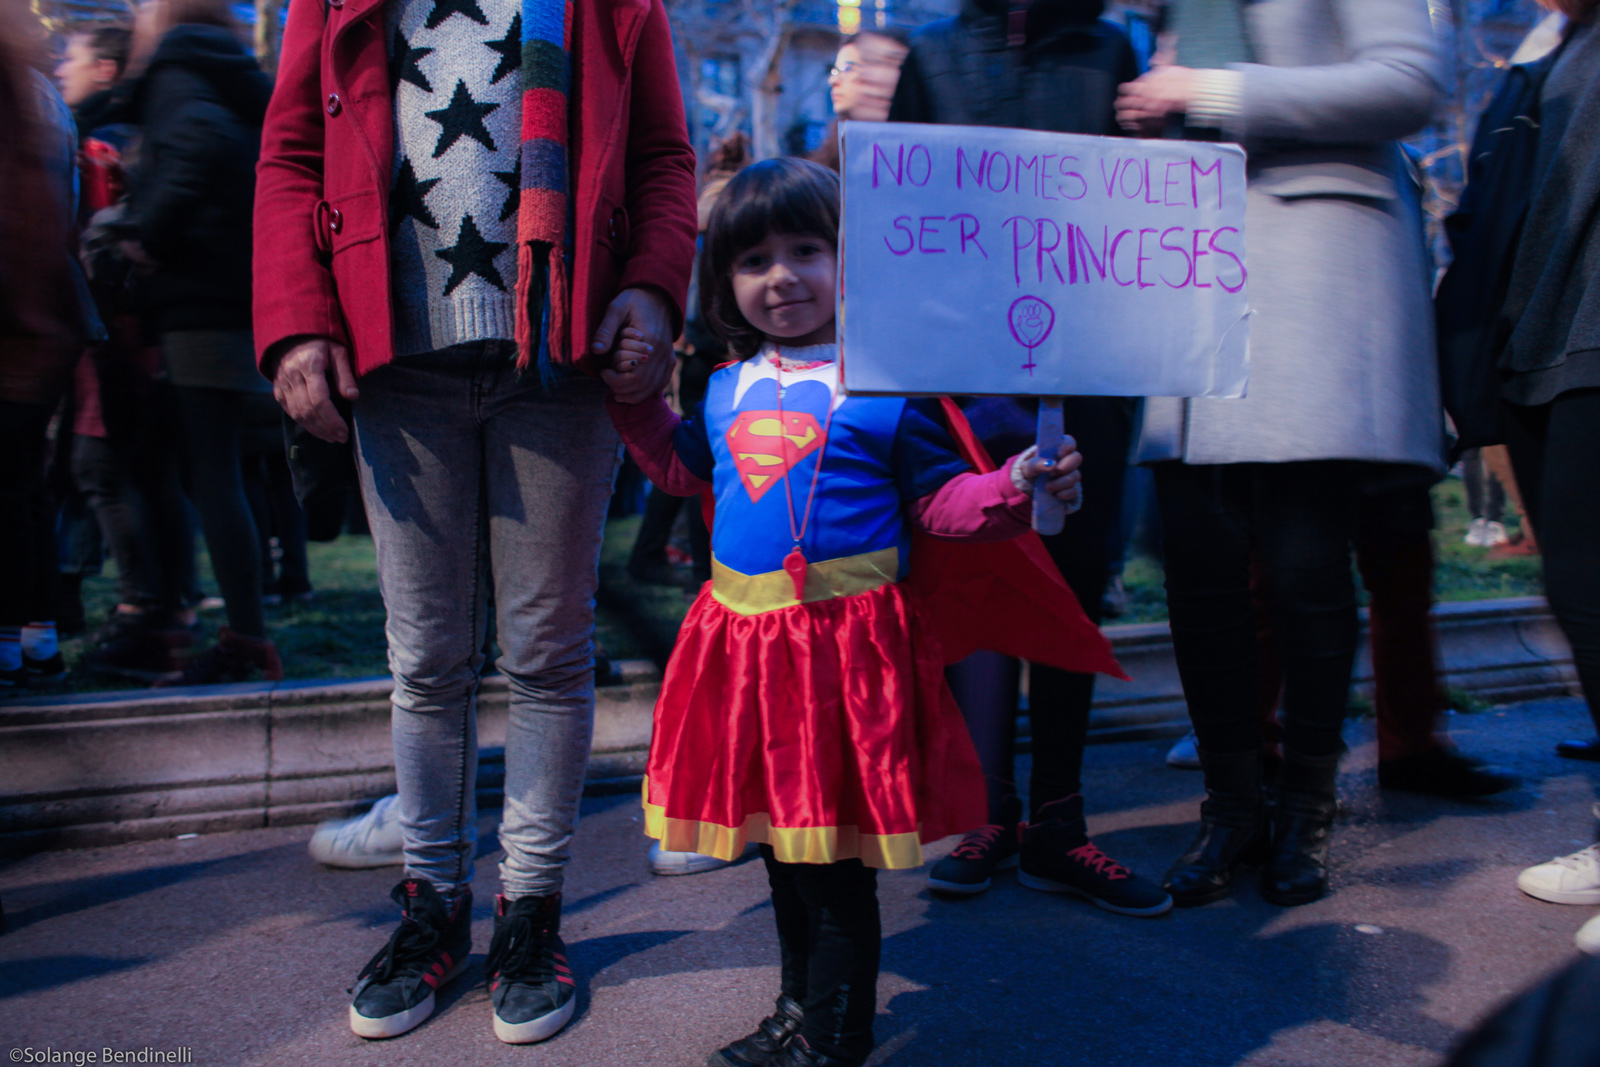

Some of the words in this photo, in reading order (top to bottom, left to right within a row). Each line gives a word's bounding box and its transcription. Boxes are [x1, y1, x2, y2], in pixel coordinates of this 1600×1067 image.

[871, 142, 932, 189] NO
[956, 146, 1088, 201] NOMES
[1100, 156, 1223, 209] VOLEM
[883, 213, 988, 259] SER
[1001, 216, 1248, 293] PRINCESES
